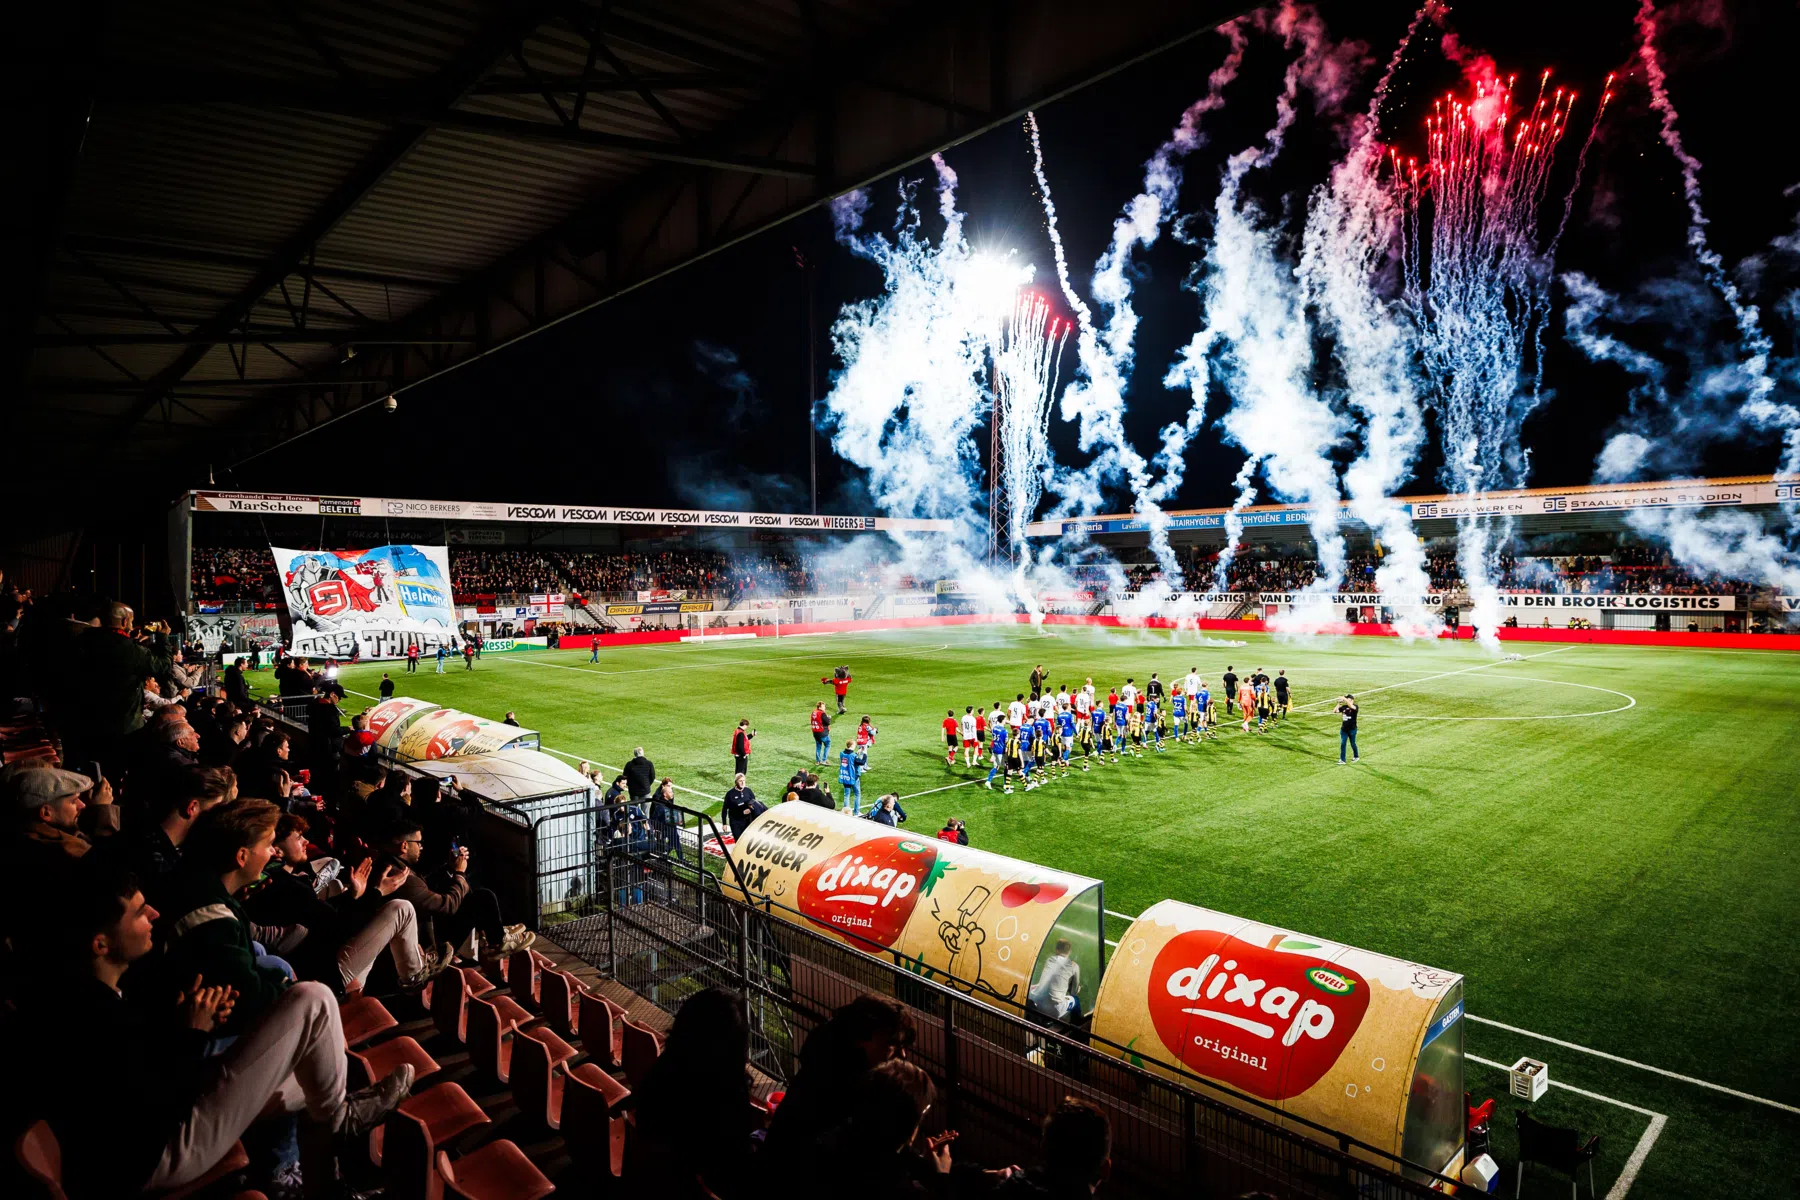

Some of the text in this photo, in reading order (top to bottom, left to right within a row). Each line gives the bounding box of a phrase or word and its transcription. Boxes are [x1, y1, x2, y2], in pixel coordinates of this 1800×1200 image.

[229, 500, 302, 512] MarSchee
[508, 507, 555, 518] VESCOM
[562, 509, 607, 520] VESCOM
[614, 511, 655, 522] VESCOM
[661, 513, 700, 523] VESCOM
[705, 514, 739, 524] VESCOM
[750, 516, 781, 525] VESCOM
[790, 517, 819, 526] VESCOM
[823, 517, 858, 528] WIEGERS
[402, 585, 448, 608] Helmond
[1524, 597, 1555, 606] DEN
[1562, 597, 1618, 607] BROEK
[1626, 598, 1720, 608] LOGISTICS
[296, 632, 354, 656] ONS
[482, 640, 514, 650] Kessel
[798, 832, 824, 850] en
[817, 855, 916, 907] dixap
[832, 914, 873, 928] original
[1314, 972, 1345, 990] COVELT
[1166, 954, 1335, 1046] dixap
[1442, 1006, 1460, 1027] GASTEN
[1194, 1036, 1268, 1070] original
